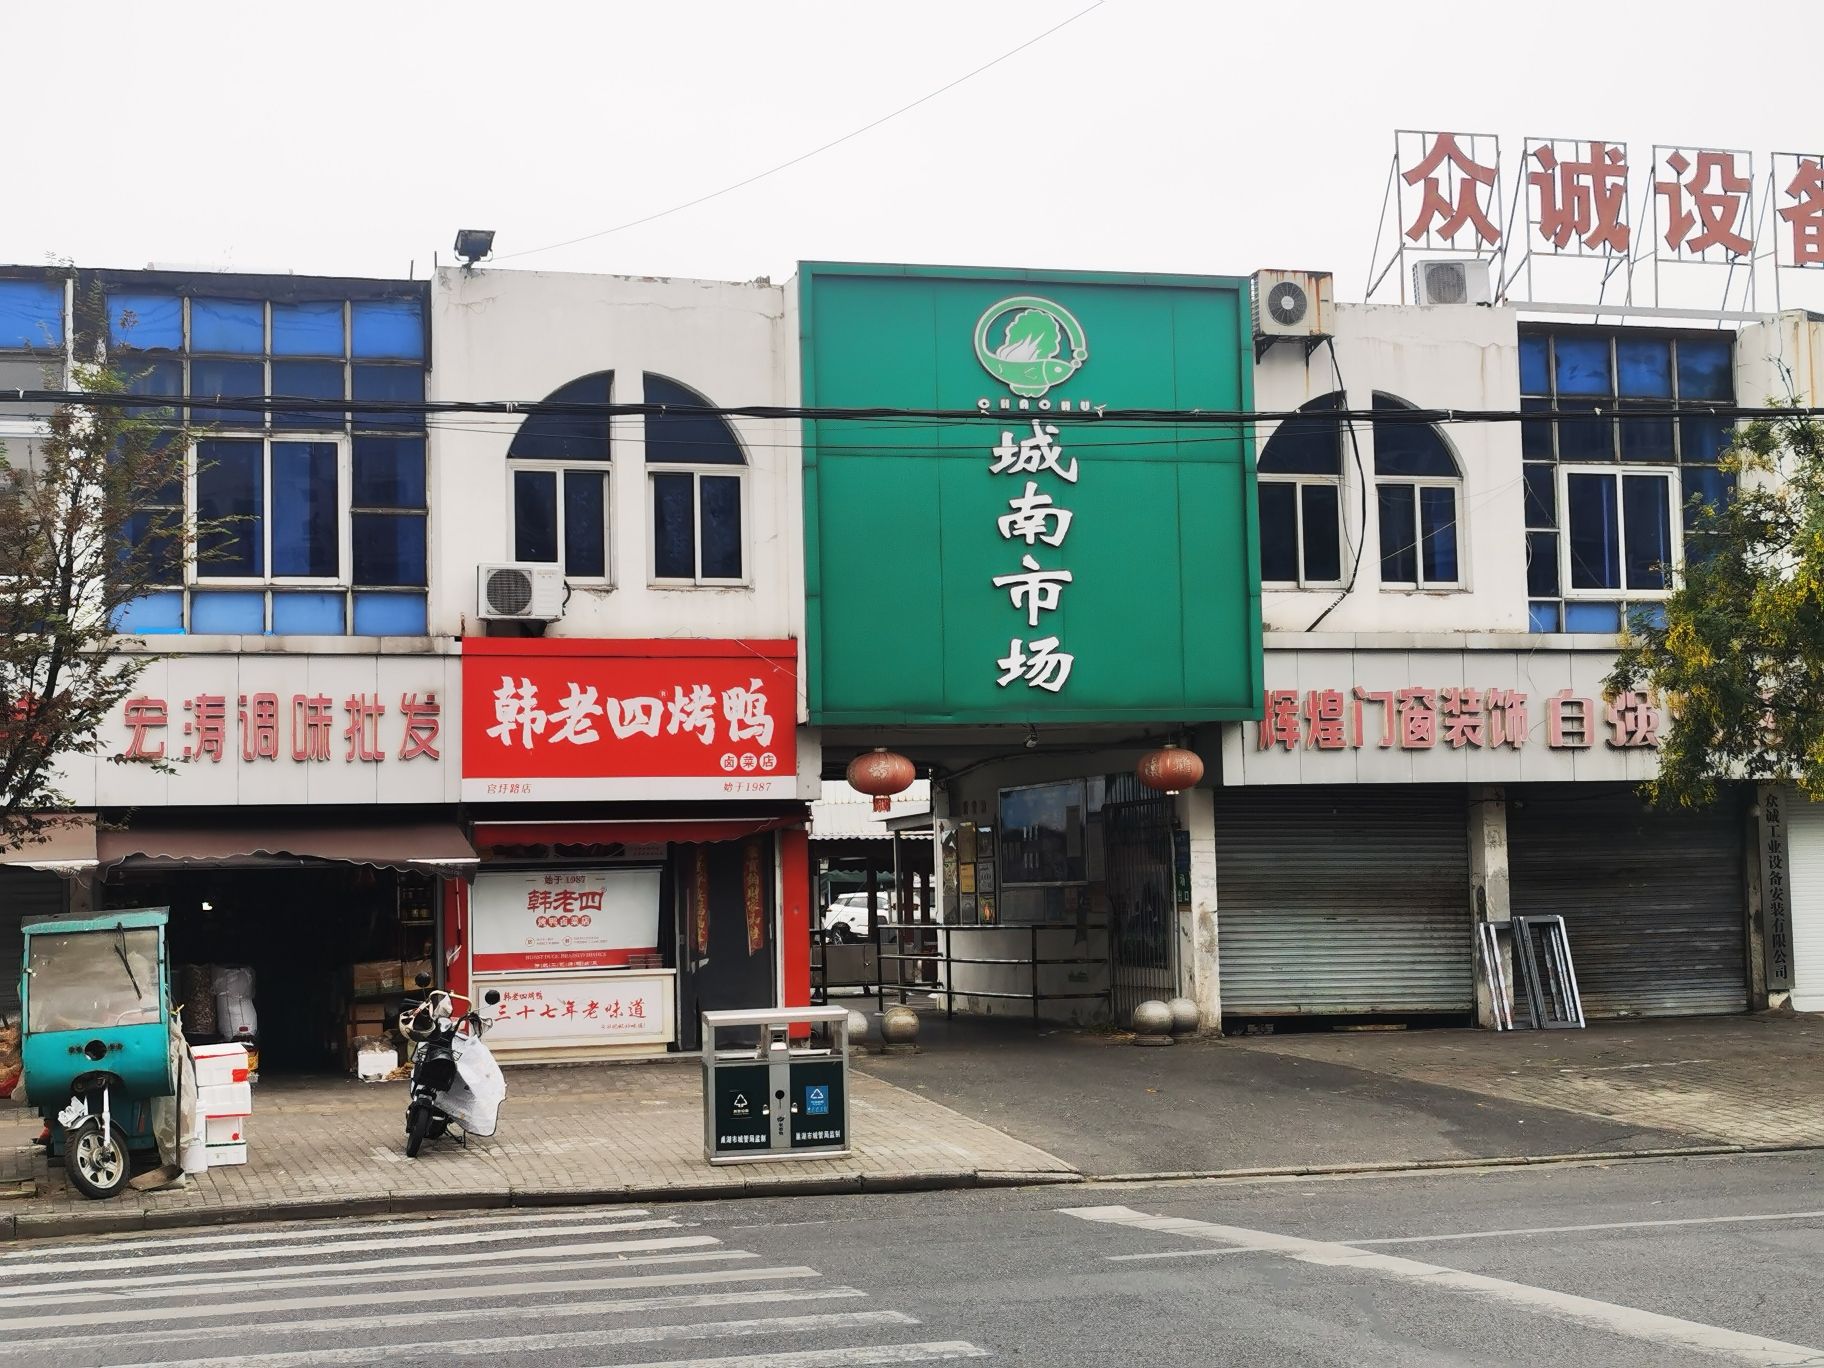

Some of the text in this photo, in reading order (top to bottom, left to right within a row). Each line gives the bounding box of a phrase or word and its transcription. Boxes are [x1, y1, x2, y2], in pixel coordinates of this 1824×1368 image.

[989, 418, 1078, 692] 城南市场
[124, 692, 441, 762] 宏涛调味批发
[486, 676, 775, 749] 韩老四烤鸭
[1258, 686, 1529, 749] 辉煌门窗装饰
[722, 753, 776, 770] 卤菜店
[723, 781, 771, 792] 始于1987
[527, 889, 605, 913] 韩老四
[495, 998, 647, 1022] 三十七年老味道
